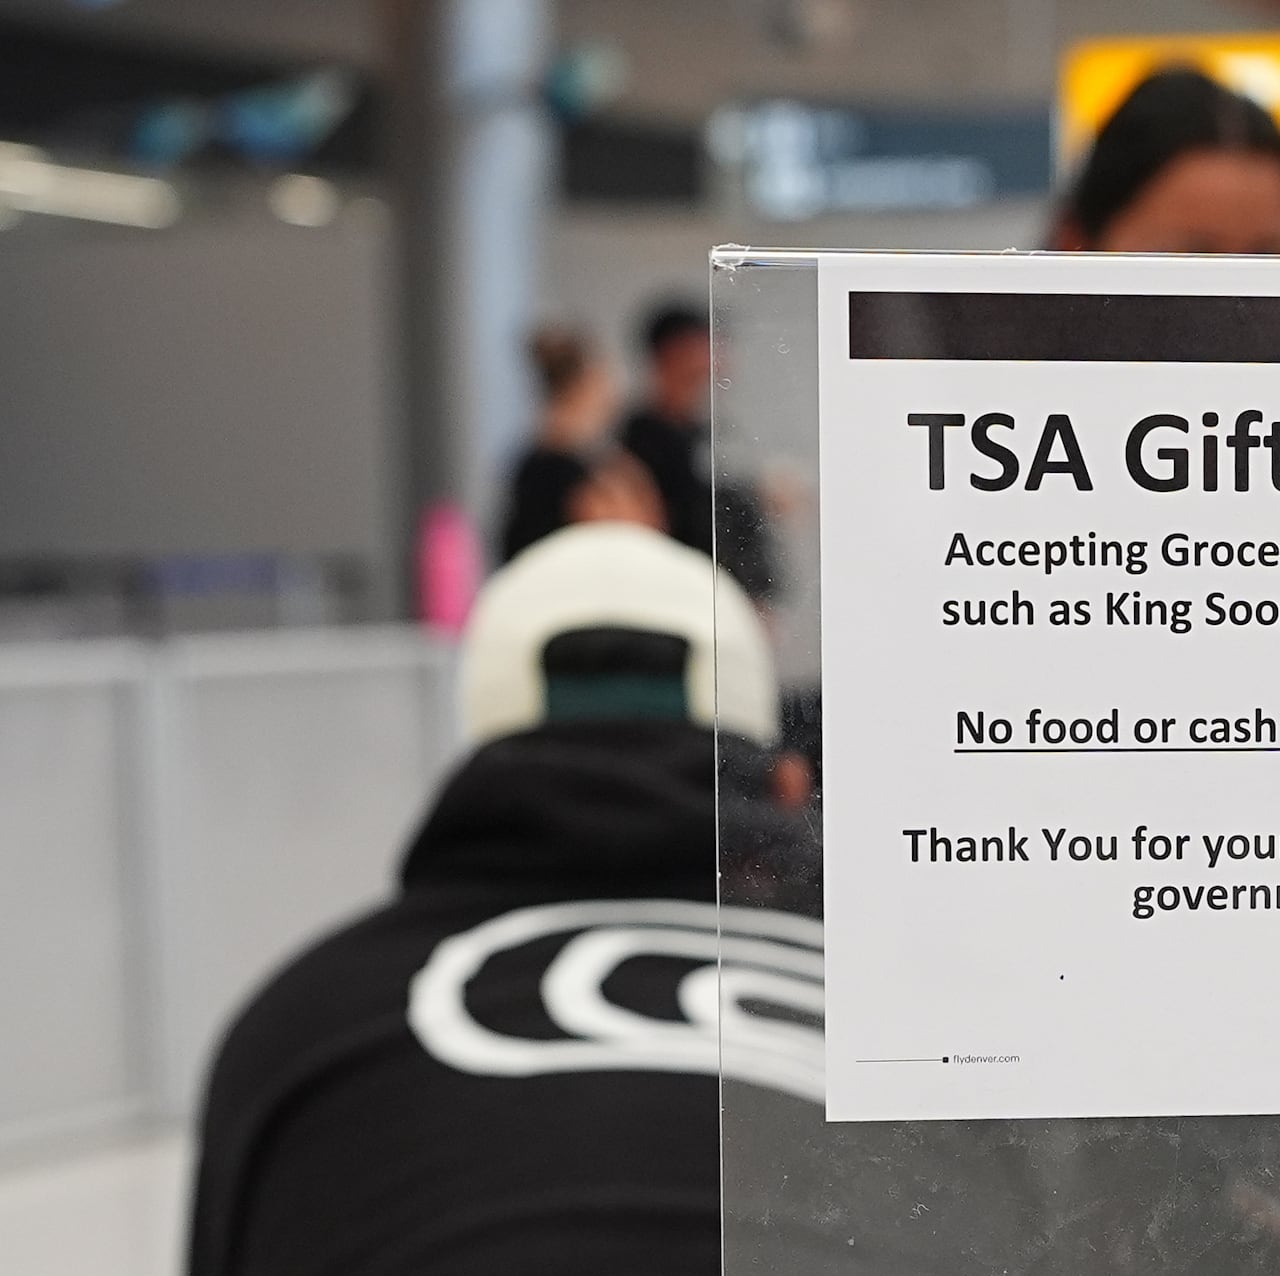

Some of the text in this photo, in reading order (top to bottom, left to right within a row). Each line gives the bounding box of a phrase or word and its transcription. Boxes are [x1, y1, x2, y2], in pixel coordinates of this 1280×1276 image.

[908, 413, 1093, 491] TSA
[945, 532, 1147, 574] Accepting
[943, 590, 1033, 625] such
[1050, 601, 1090, 625] as
[1107, 591, 1192, 633] King
[958, 712, 1012, 744] No
[1026, 709, 1118, 743] food
[1134, 719, 1176, 743] or
[1190, 708, 1276, 743] cash
[903, 827, 1029, 862] Thank
[1042, 829, 1117, 860] You
[1132, 826, 1190, 860] for
[952, 1053, 1021, 1066] flydenver.com
